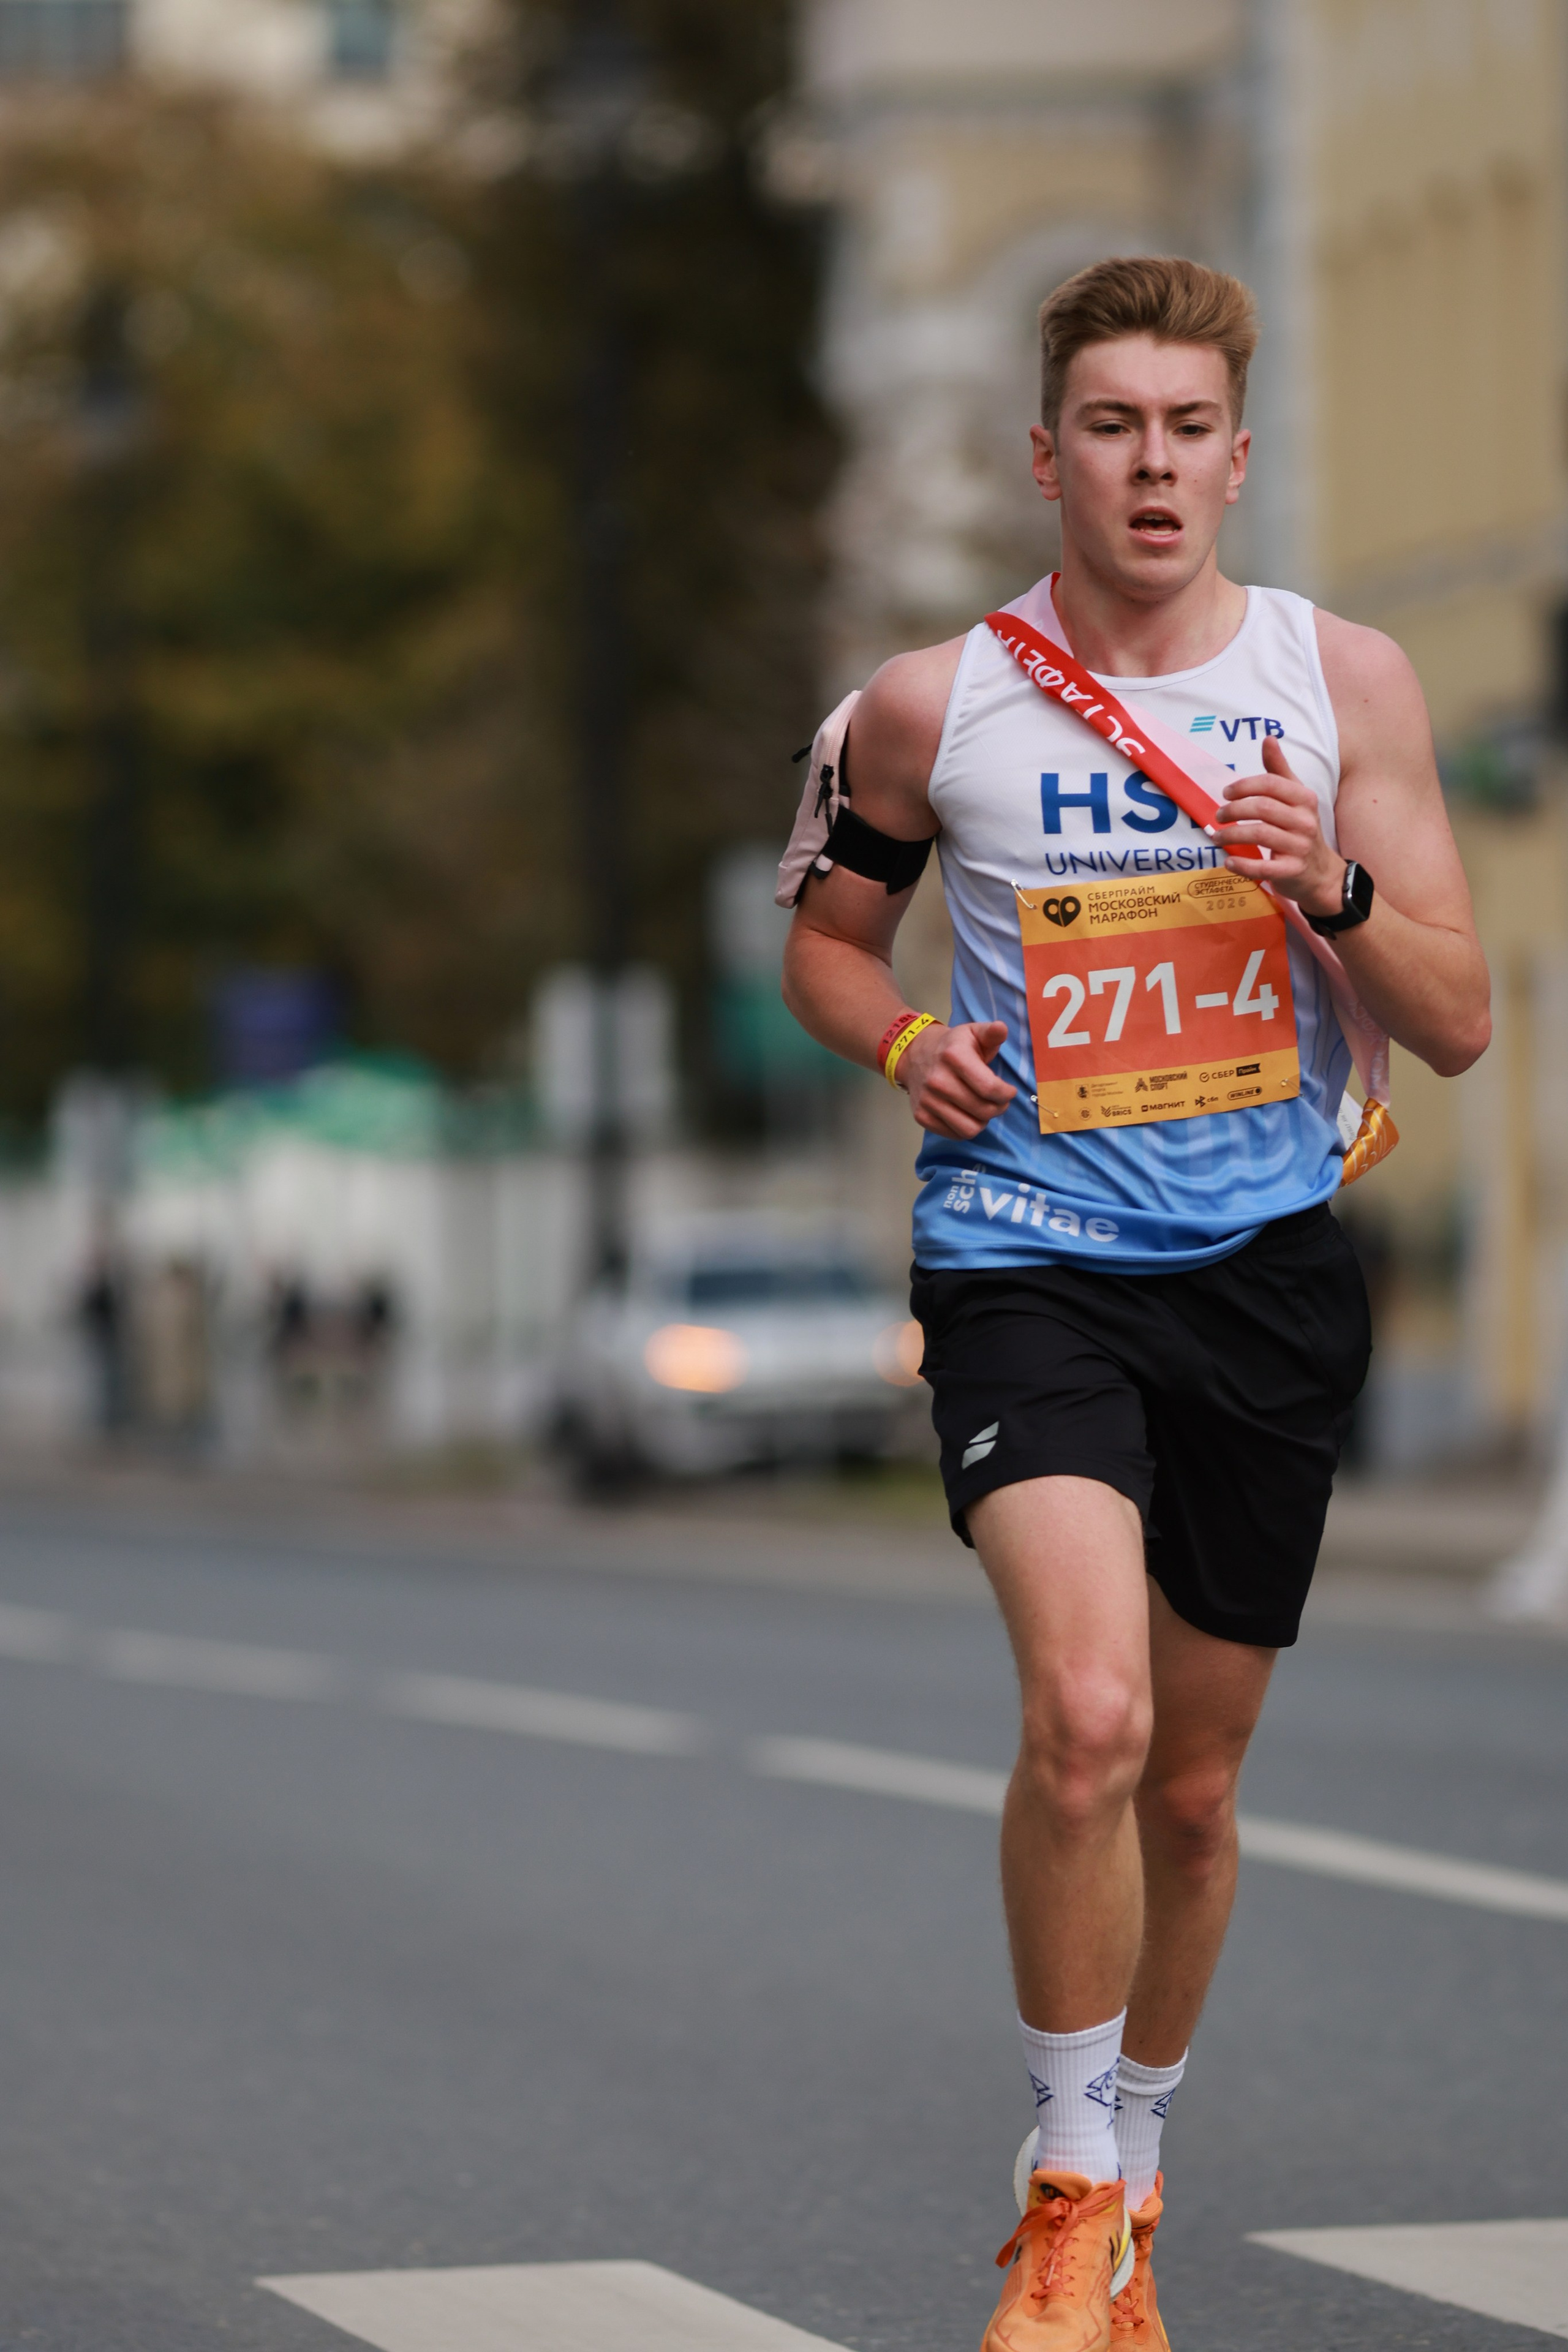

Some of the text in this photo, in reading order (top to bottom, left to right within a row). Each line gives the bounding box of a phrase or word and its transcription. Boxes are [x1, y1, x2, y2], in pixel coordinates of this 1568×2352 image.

[1219, 717, 1284, 742] VTB
[1040, 764, 1235, 834] HS
[1045, 846, 1224, 875] UNIVERSIT
[1087, 886, 1155, 900] СБЕРПРАЙМ
[1194, 876, 1252, 889] СТУДЕНЧЕСКА
[1195, 886, 1234, 895] ЭСТАФЕТА
[1088, 892, 1181, 913] МОСКОВСКИЙ
[1206, 896, 1246, 911] 2026
[1090, 908, 1158, 924] МАРАФОН
[1042, 949, 1279, 1048] 271-4
[895, 1017, 930, 1052] 271-4
[1212, 1069, 1235, 1079] СБЕР
[943, 1185, 959, 1208] non
[979, 1183, 1120, 1242] vitae
